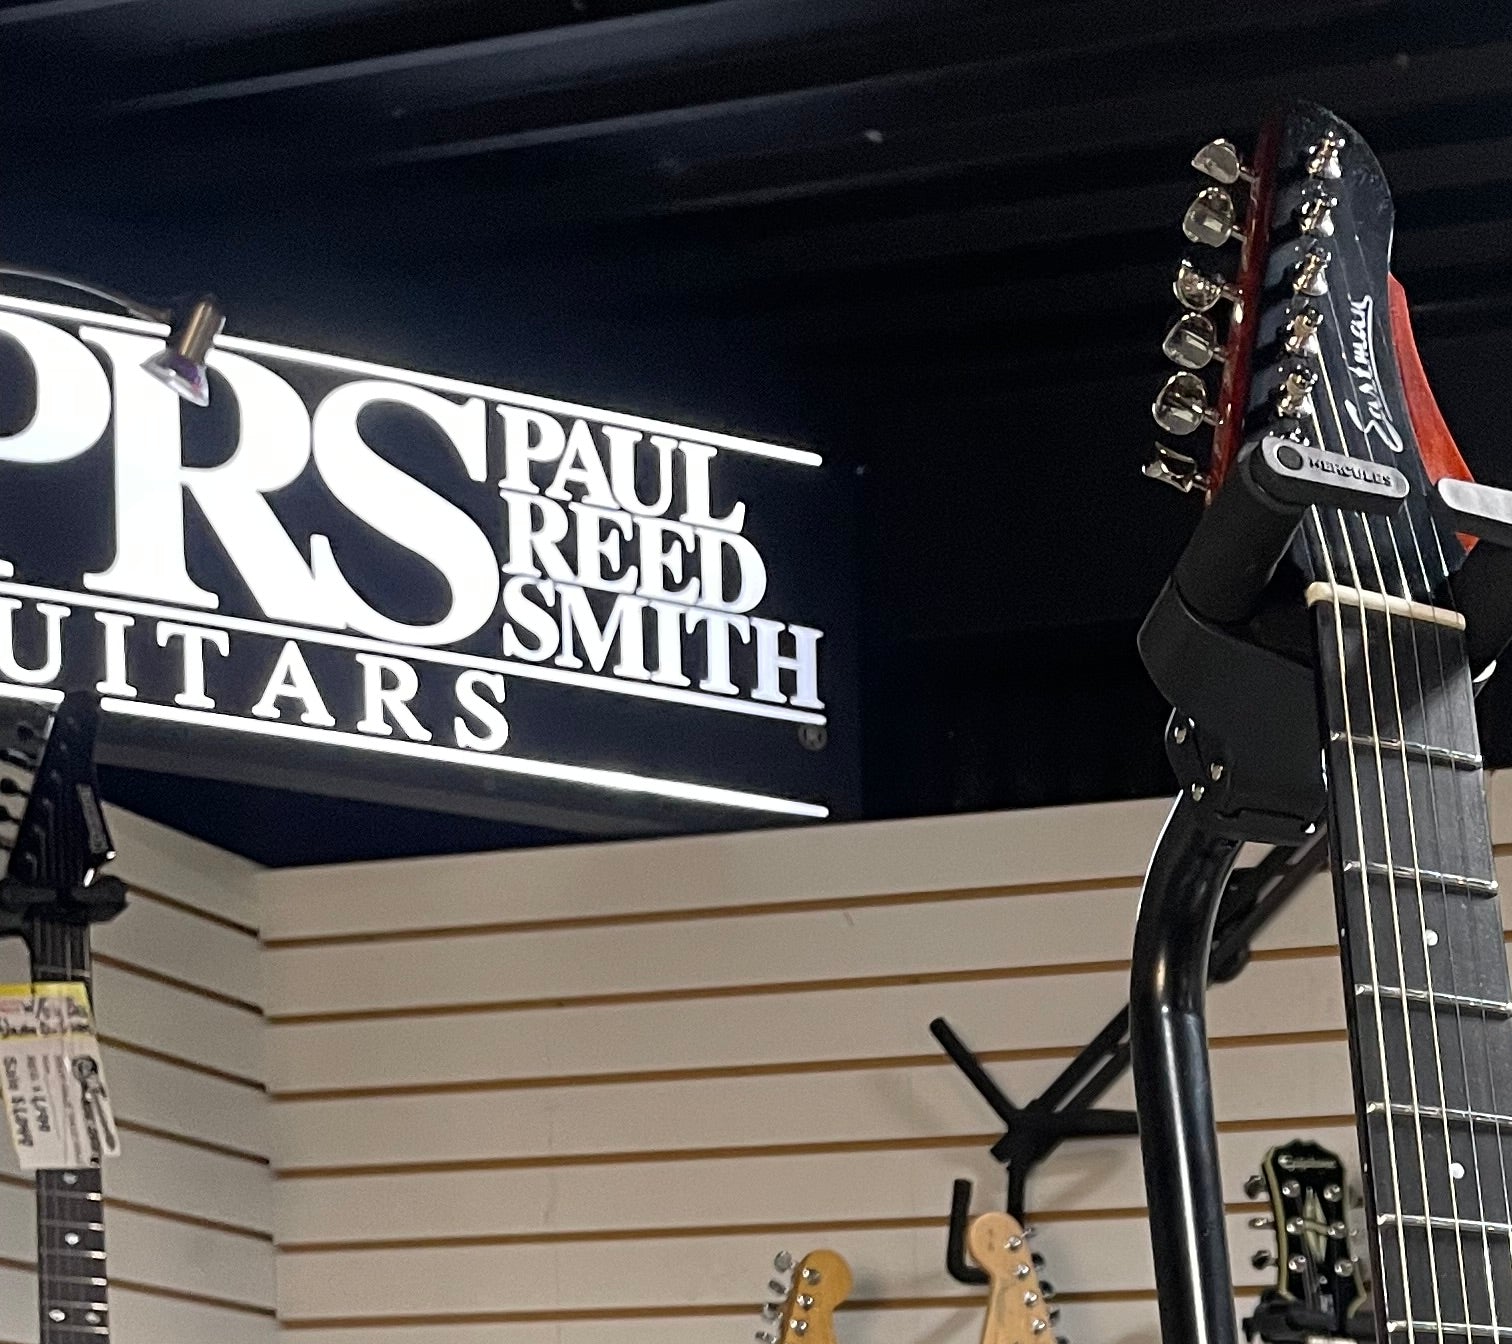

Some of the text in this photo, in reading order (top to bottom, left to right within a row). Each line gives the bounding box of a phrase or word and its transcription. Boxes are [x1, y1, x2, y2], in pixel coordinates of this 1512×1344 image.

[496, 403, 746, 533] PAUL
[1308, 457, 1393, 487] HERCULES
[499, 489, 767, 614] REED
[502, 575, 826, 709] SMITH
